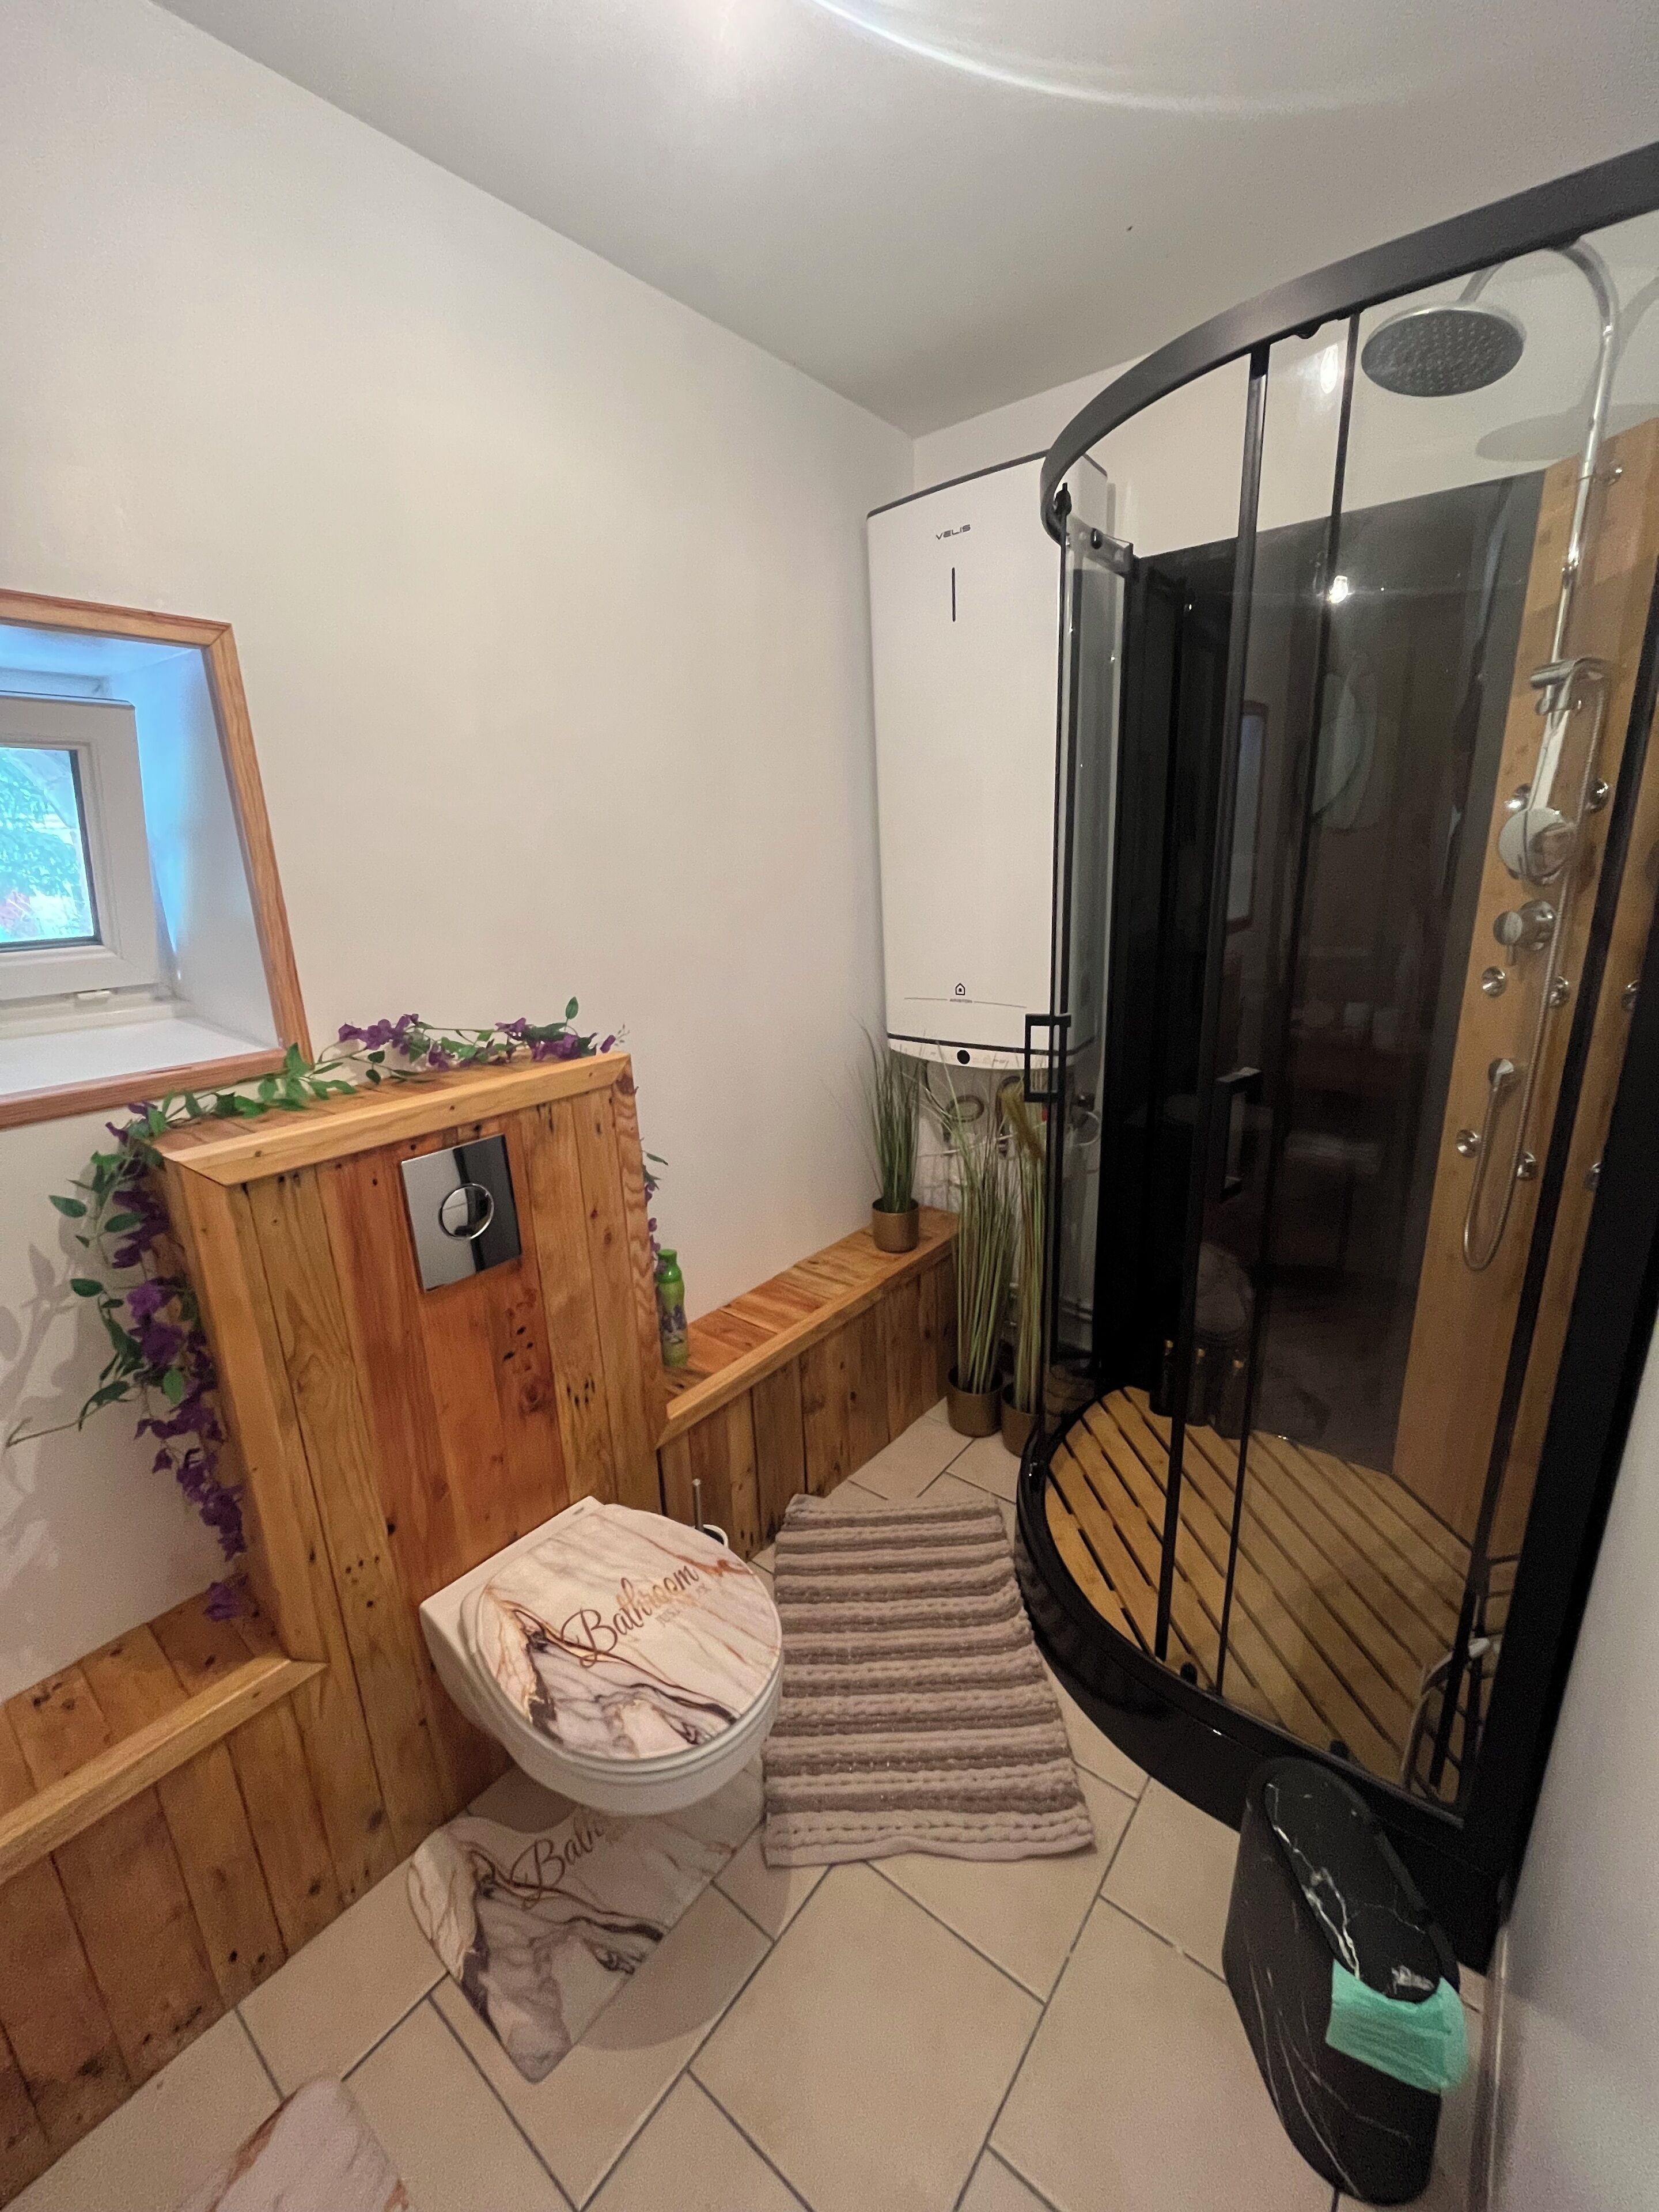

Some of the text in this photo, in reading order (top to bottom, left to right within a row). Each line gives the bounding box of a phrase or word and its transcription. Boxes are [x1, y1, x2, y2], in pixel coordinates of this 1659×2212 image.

[935, 524, 971, 540] VELIS
[560, 1565, 699, 1668] Bathroom
[510, 1810, 605, 1911] Bath
